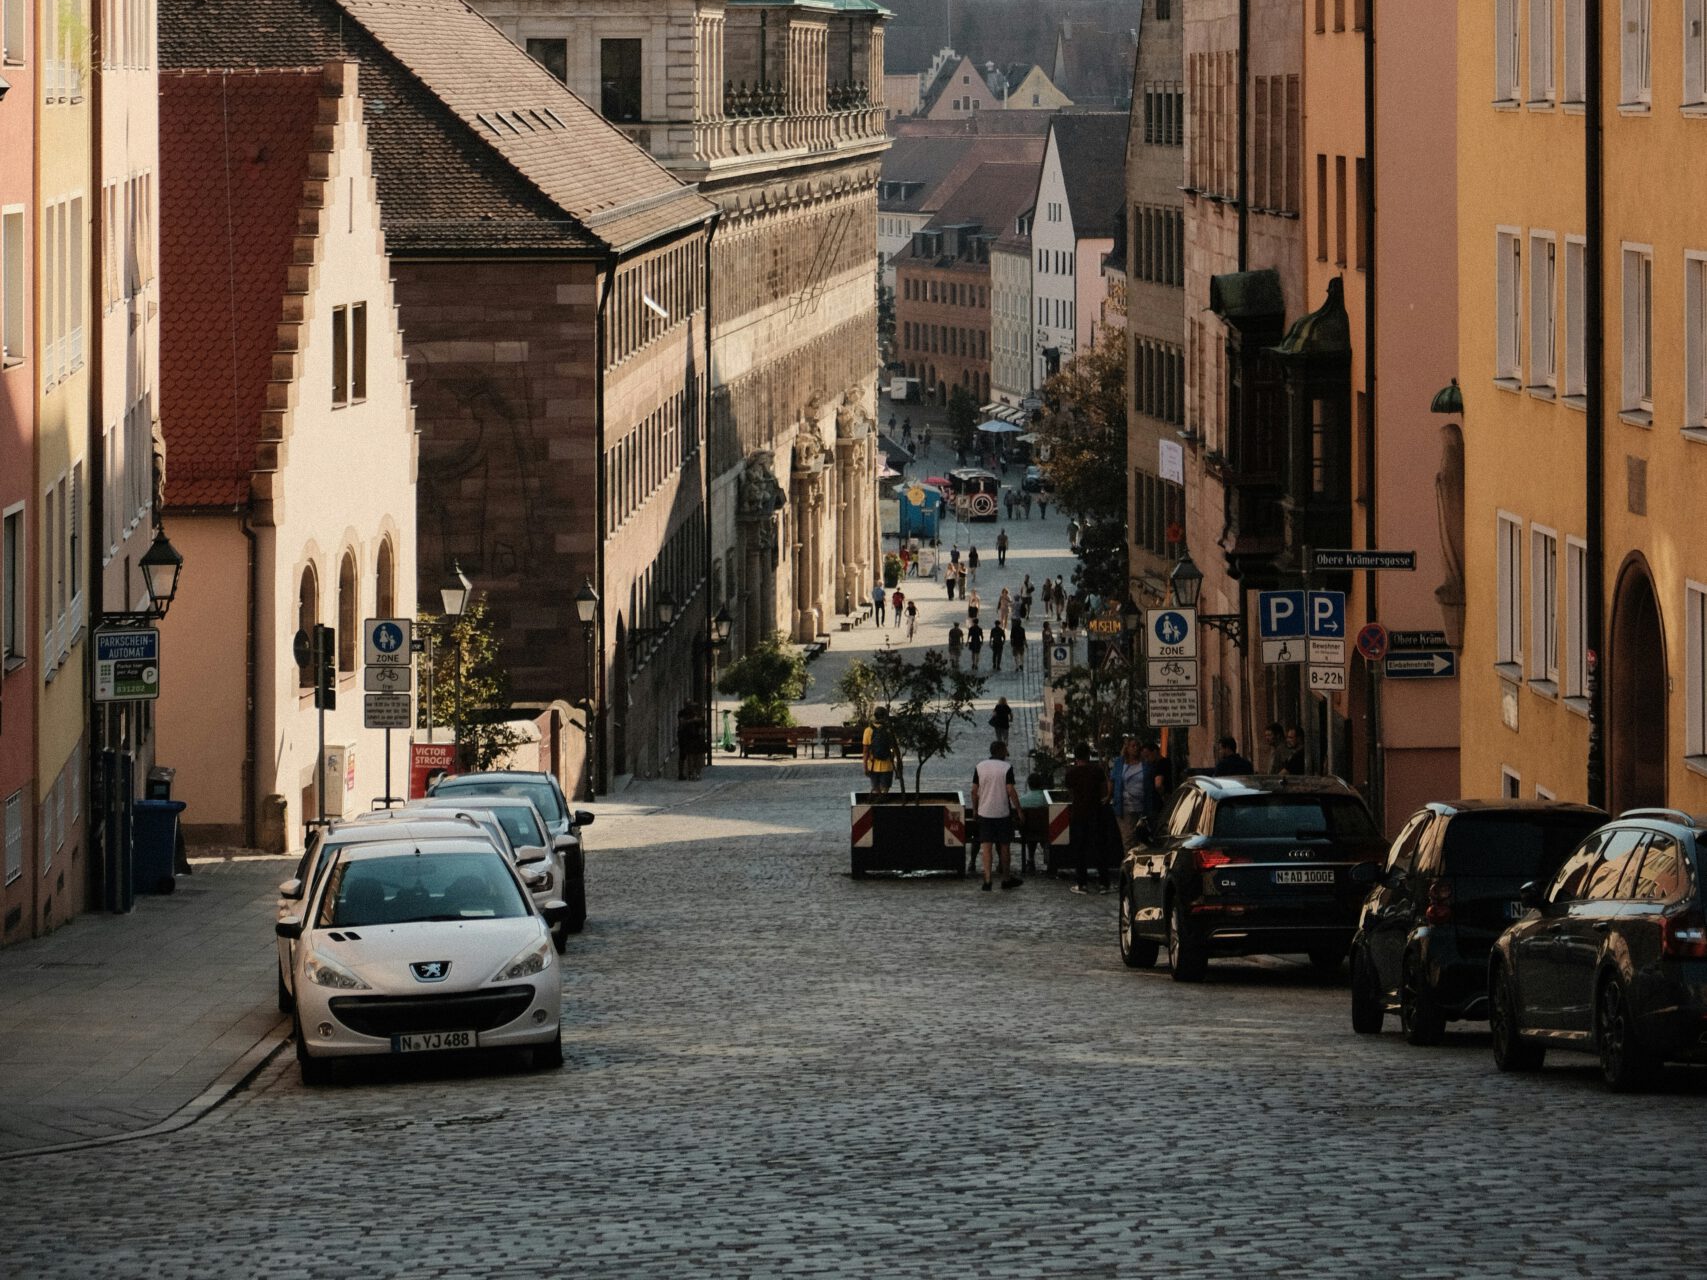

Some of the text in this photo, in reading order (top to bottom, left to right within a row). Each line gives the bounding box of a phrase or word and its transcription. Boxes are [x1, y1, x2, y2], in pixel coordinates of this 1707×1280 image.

[1317, 554, 1411, 568] Obere Krämersgasse
[1270, 597, 1294, 632] P
[1314, 597, 1334, 632] P
[1089, 619, 1121, 633] MUSEUM
[100, 635, 154, 648] PARKSCHEIN-
[1312, 642, 1341, 650] Bewohner
[1393, 634, 1418, 645] Obere
[109, 647, 145, 658] AUTOMAT
[1159, 646, 1185, 656] ZONE
[376, 654, 399, 663] ZONE
[1311, 671, 1343, 685] 8-22h
[415, 747, 446, 756] VICTOR
[402, 1036, 412, 1051] N
